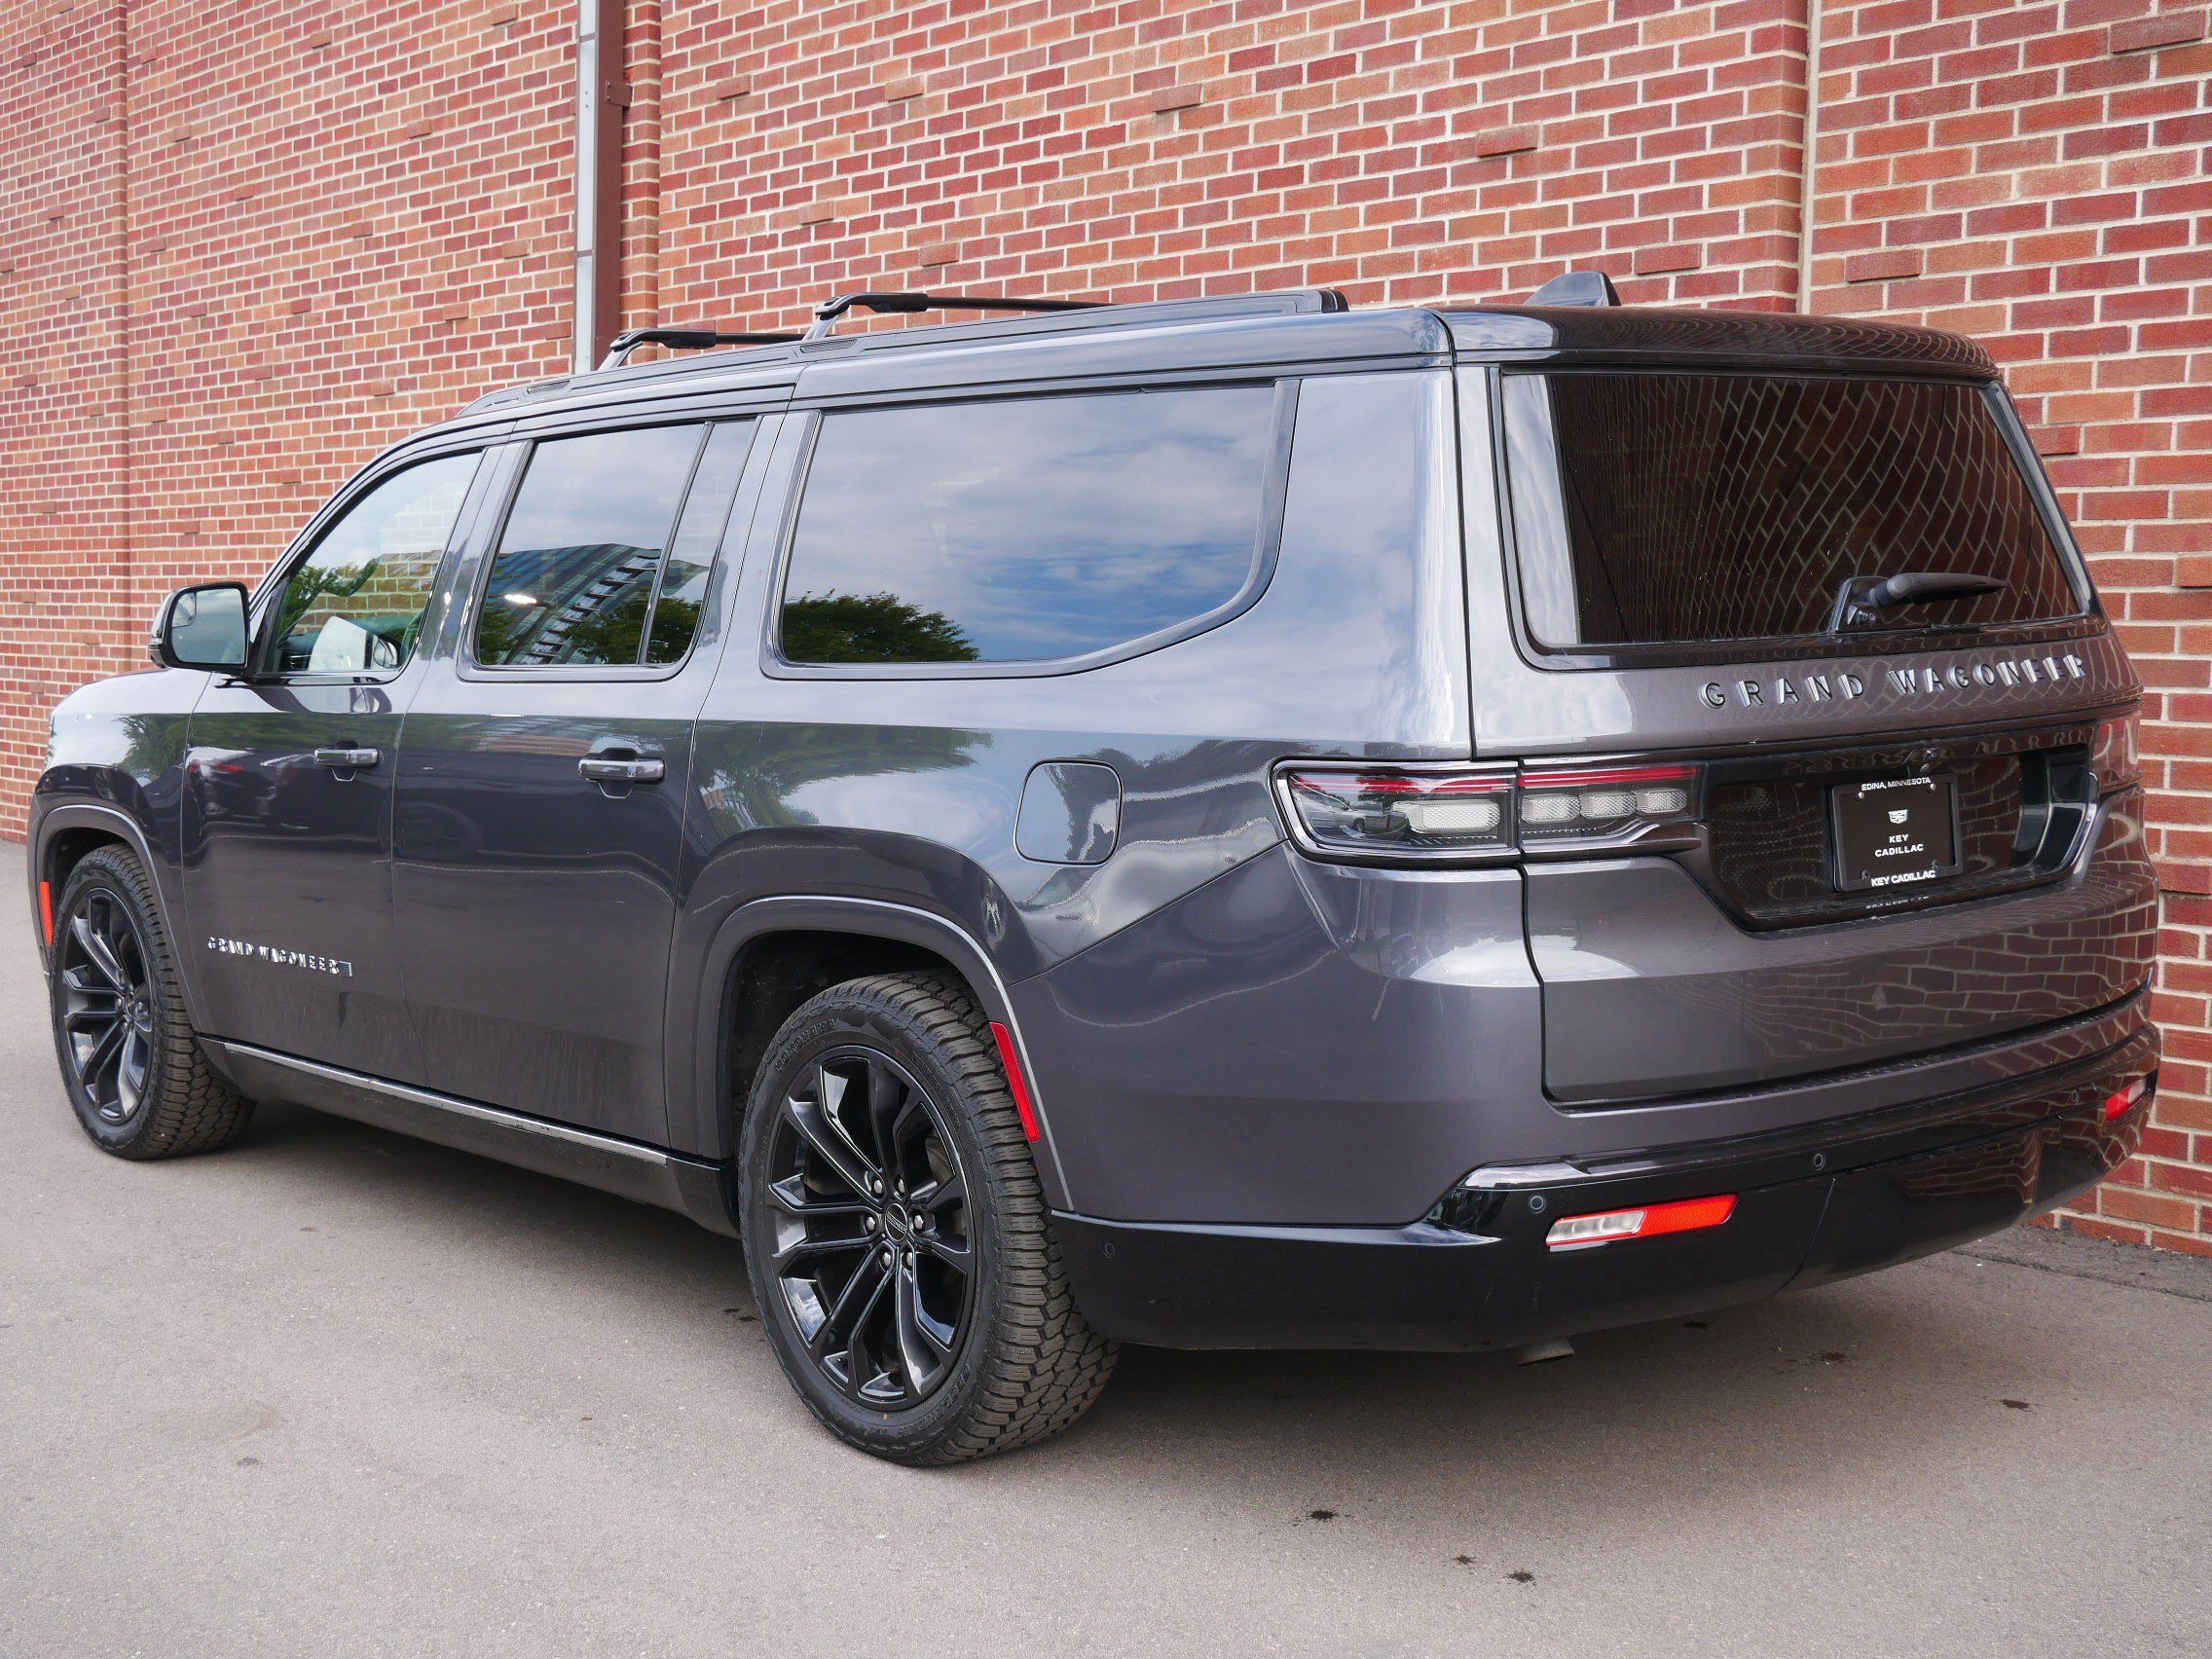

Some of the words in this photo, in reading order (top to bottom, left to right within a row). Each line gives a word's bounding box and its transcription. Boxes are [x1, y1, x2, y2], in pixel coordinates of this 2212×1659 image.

[1700, 674, 1863, 709] GRAND
[1886, 654, 2085, 695] WAGONEER
[1862, 783, 1887, 792] EDINA,
[1888, 777, 1931, 788] MINNESOTA
[1890, 834, 1908, 843] KEY
[1875, 844, 1924, 857] CADILLAC
[1871, 876, 1891, 887] KEY
[1892, 870, 1936, 883] CADILLAC
[207, 937, 254, 956] GRAND
[259, 946, 339, 974] WAGONEER
